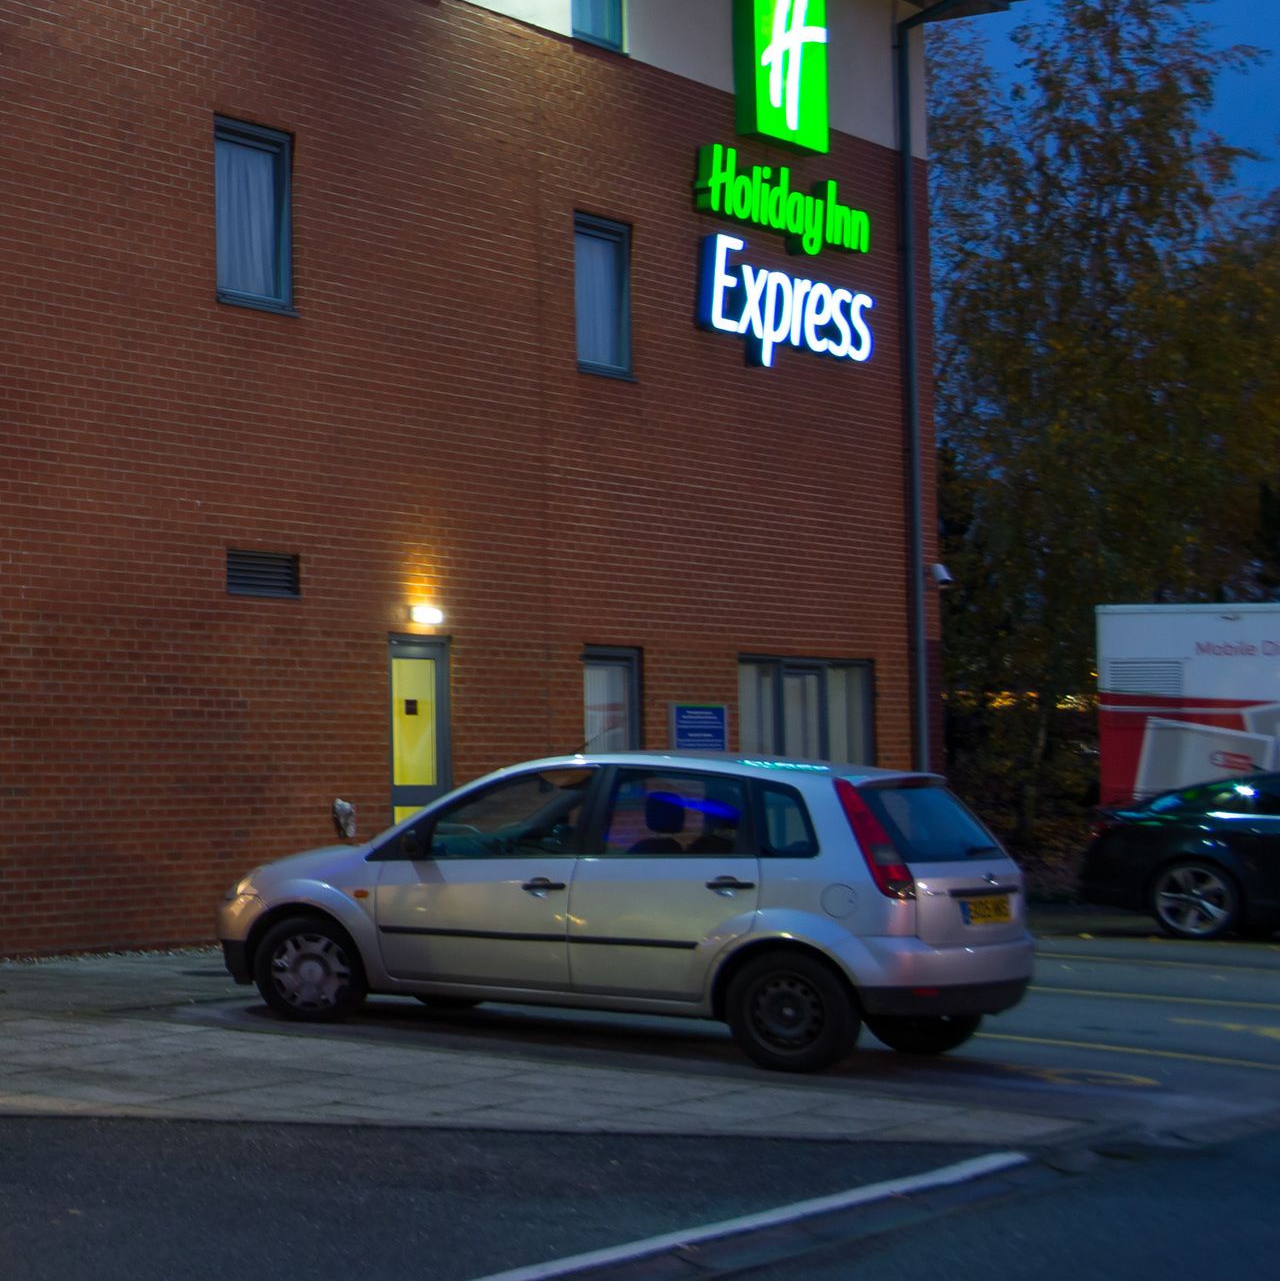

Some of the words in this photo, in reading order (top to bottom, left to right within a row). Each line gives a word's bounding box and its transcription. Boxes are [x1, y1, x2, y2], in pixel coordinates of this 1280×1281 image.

[704, 143, 823, 256] Holiday
[826, 179, 870, 254] Inn
[710, 232, 875, 368] Express
[1195, 640, 1257, 657] Mobile
